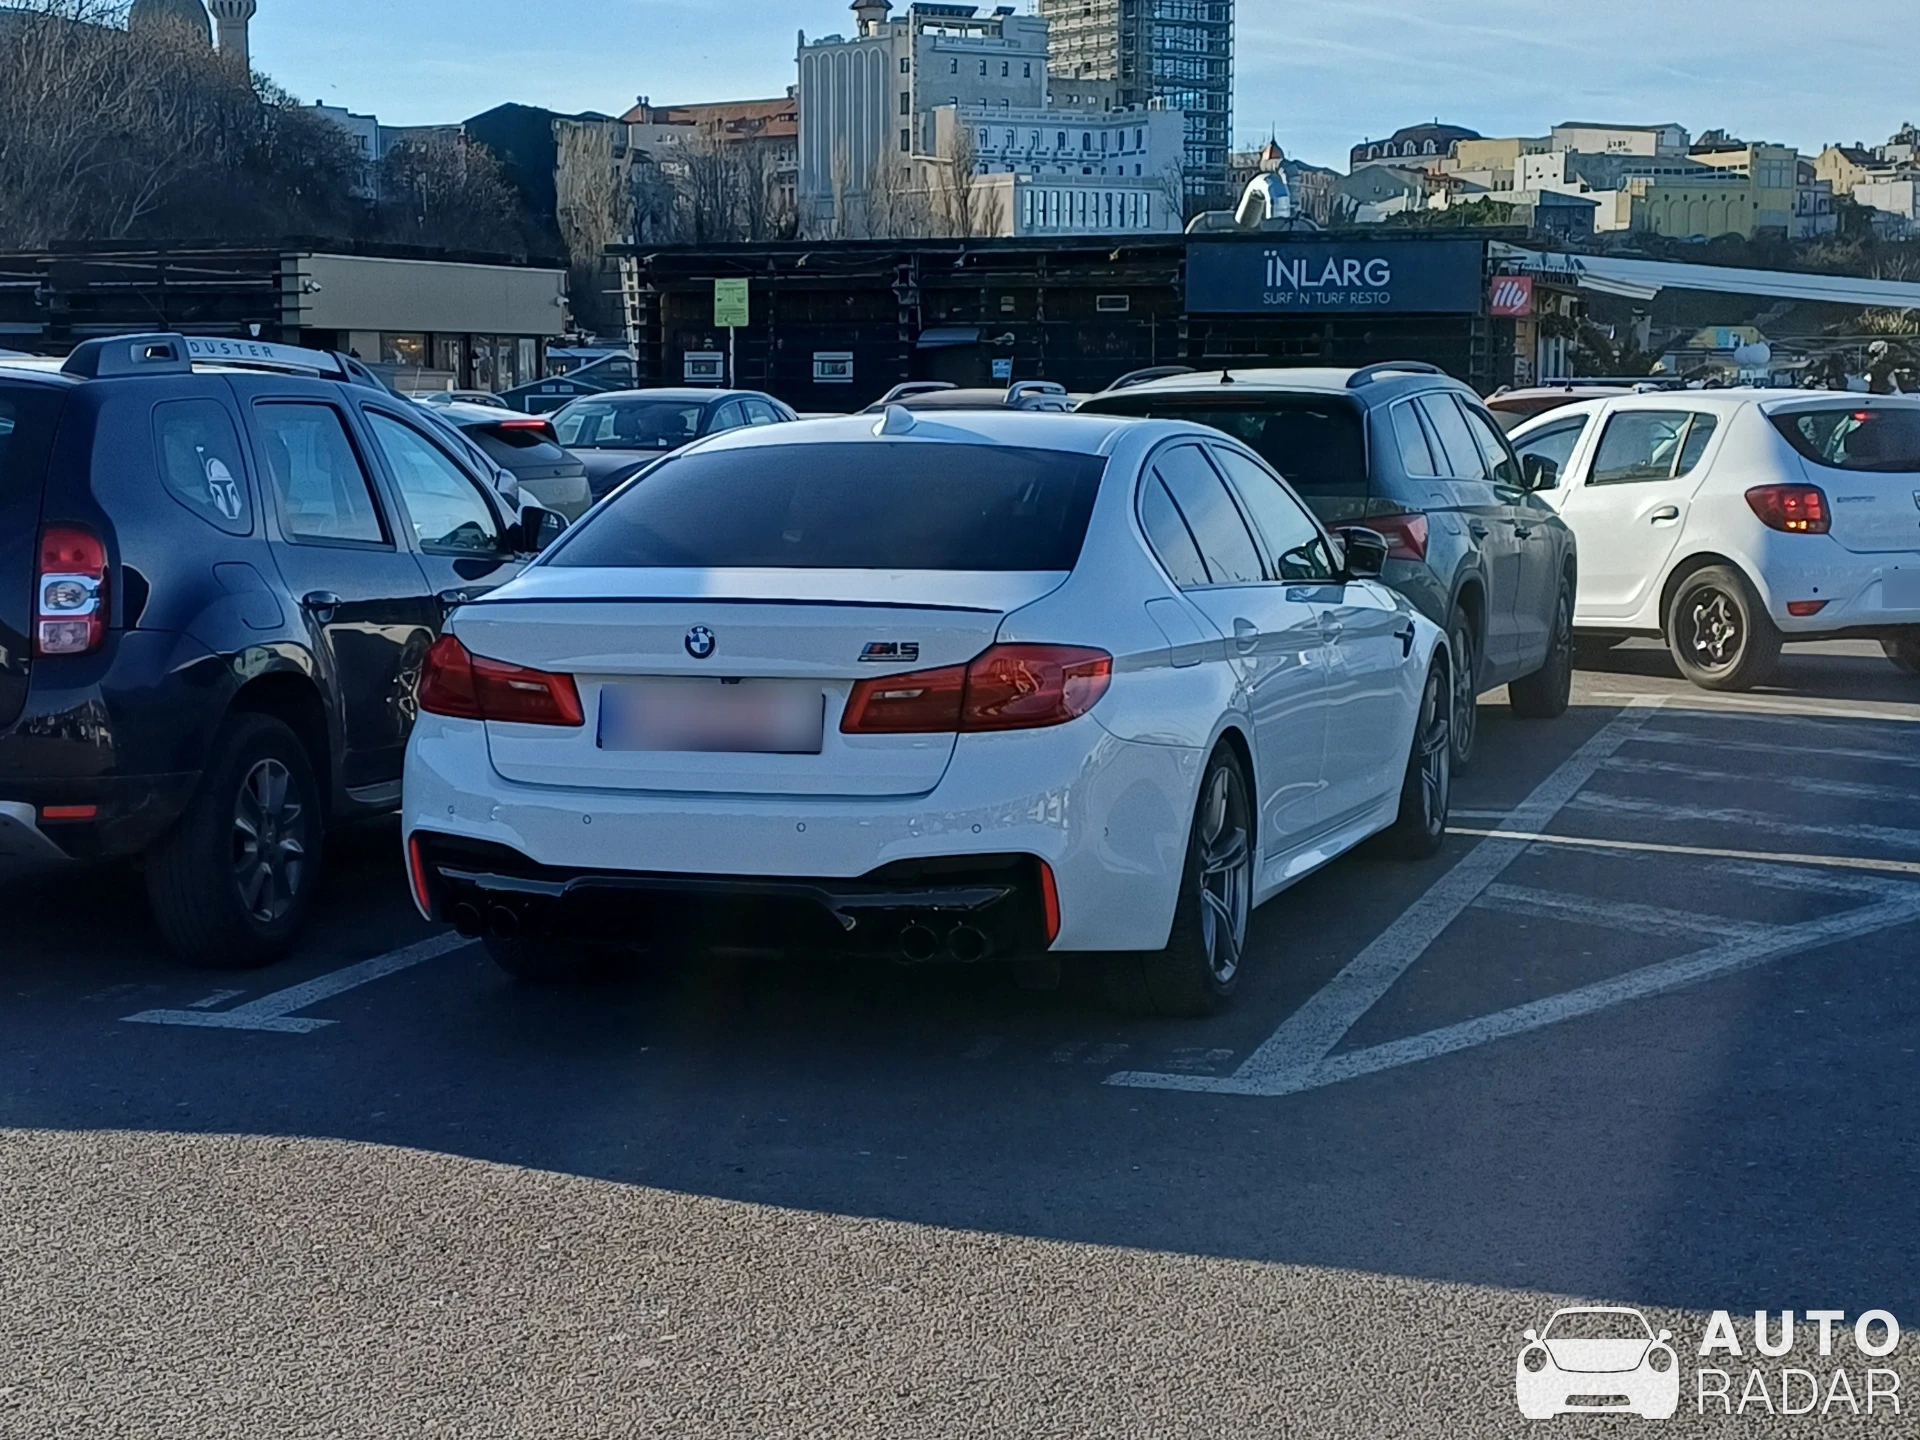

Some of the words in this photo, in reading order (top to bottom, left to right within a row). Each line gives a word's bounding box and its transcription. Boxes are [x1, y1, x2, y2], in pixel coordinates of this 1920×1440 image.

[1262, 291, 1294, 305] SURF
[1316, 291, 1346, 305] TURF
[1350, 291, 1391, 305] RESTO
[1492, 281, 1528, 313] illy
[189, 341, 274, 359] DUSTER
